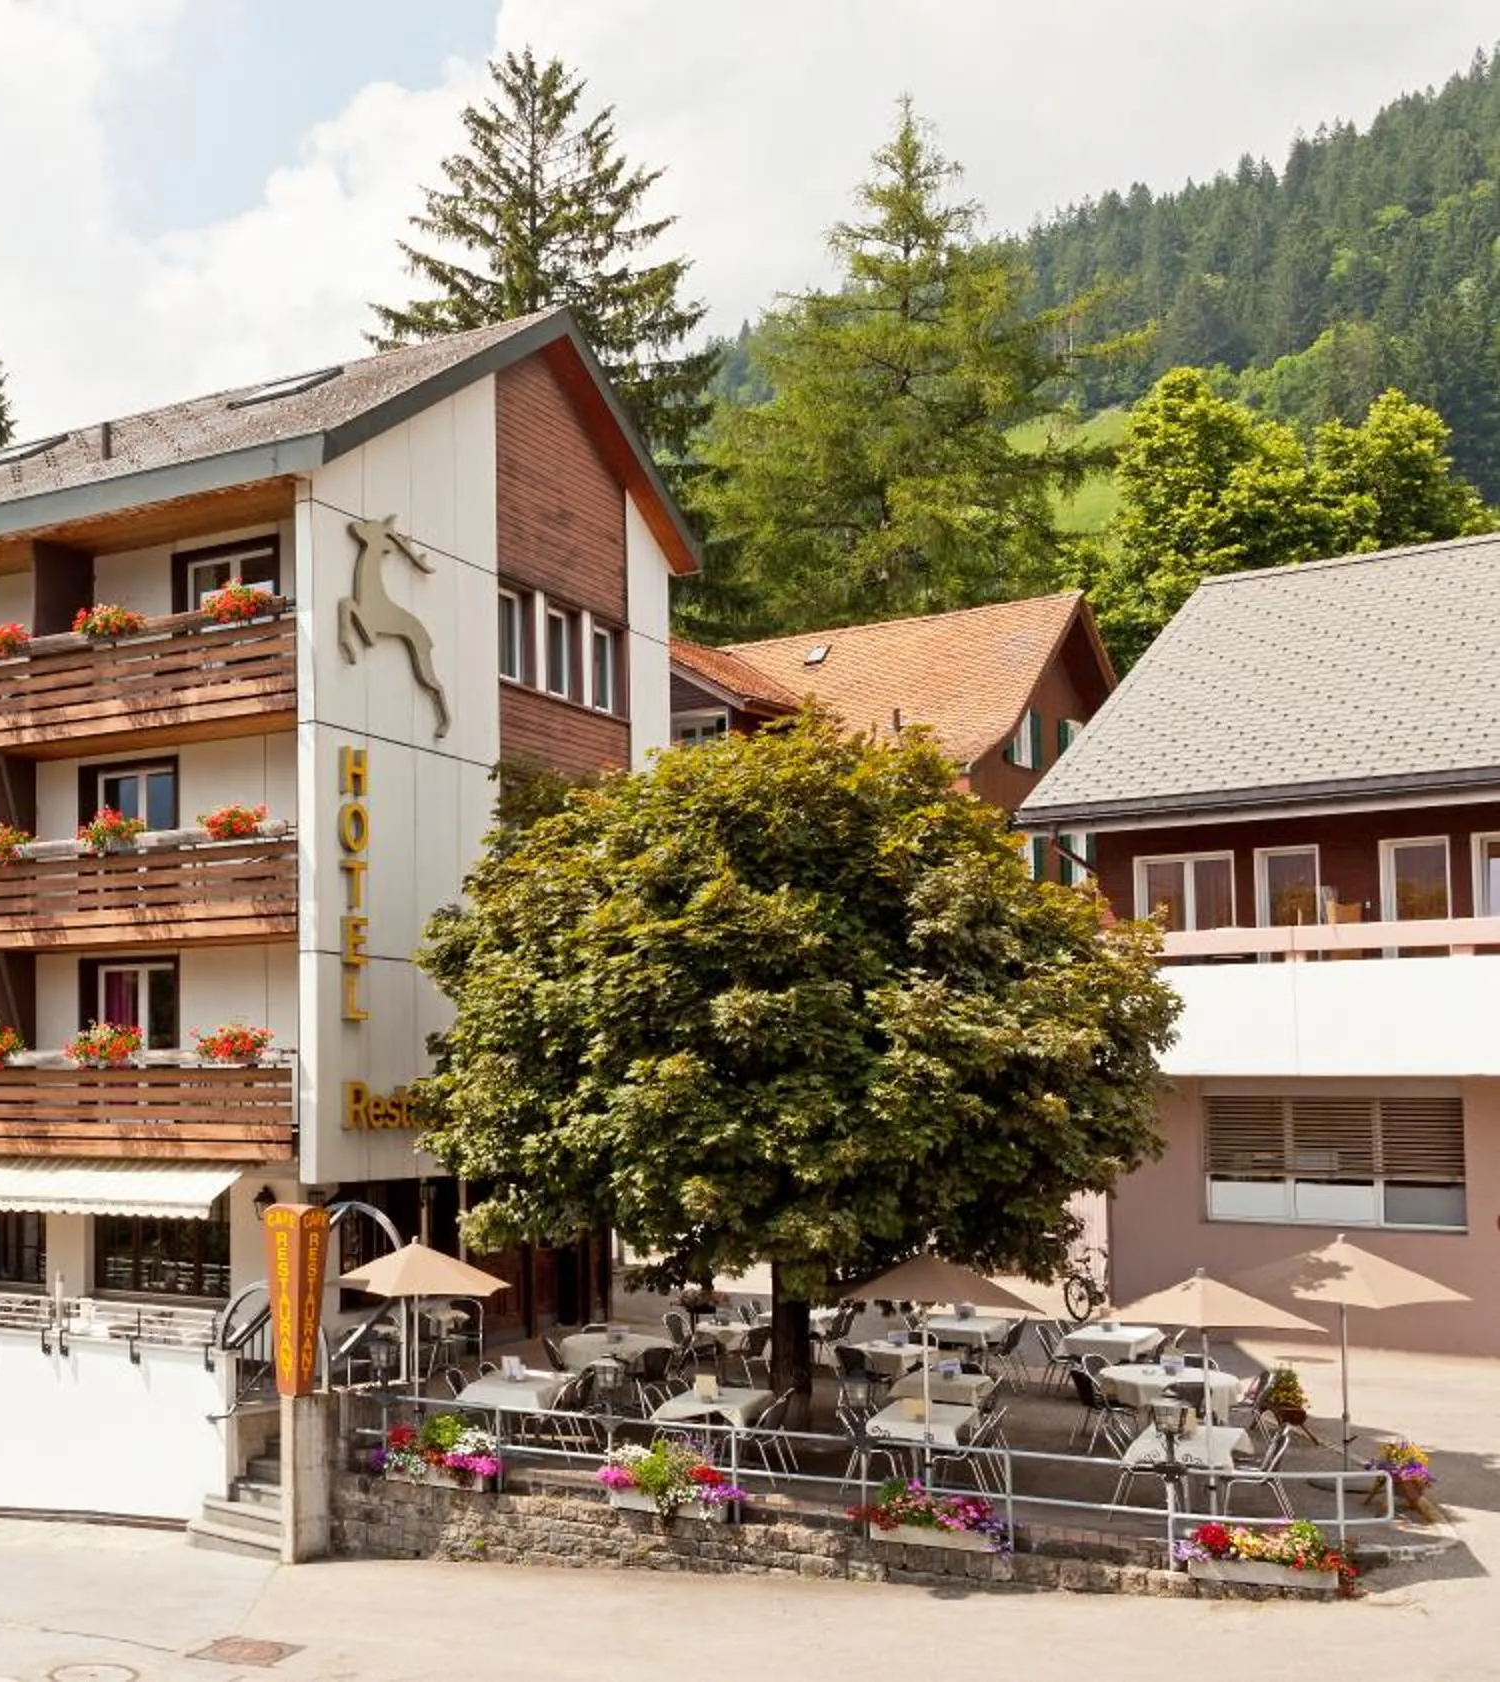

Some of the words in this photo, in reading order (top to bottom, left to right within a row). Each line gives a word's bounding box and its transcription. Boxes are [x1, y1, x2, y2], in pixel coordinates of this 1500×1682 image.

[338, 746, 369, 1021] HOTEL
[275, 1231, 293, 1382] RESTAURANT
[301, 1232, 321, 1382] RESTAURANT
